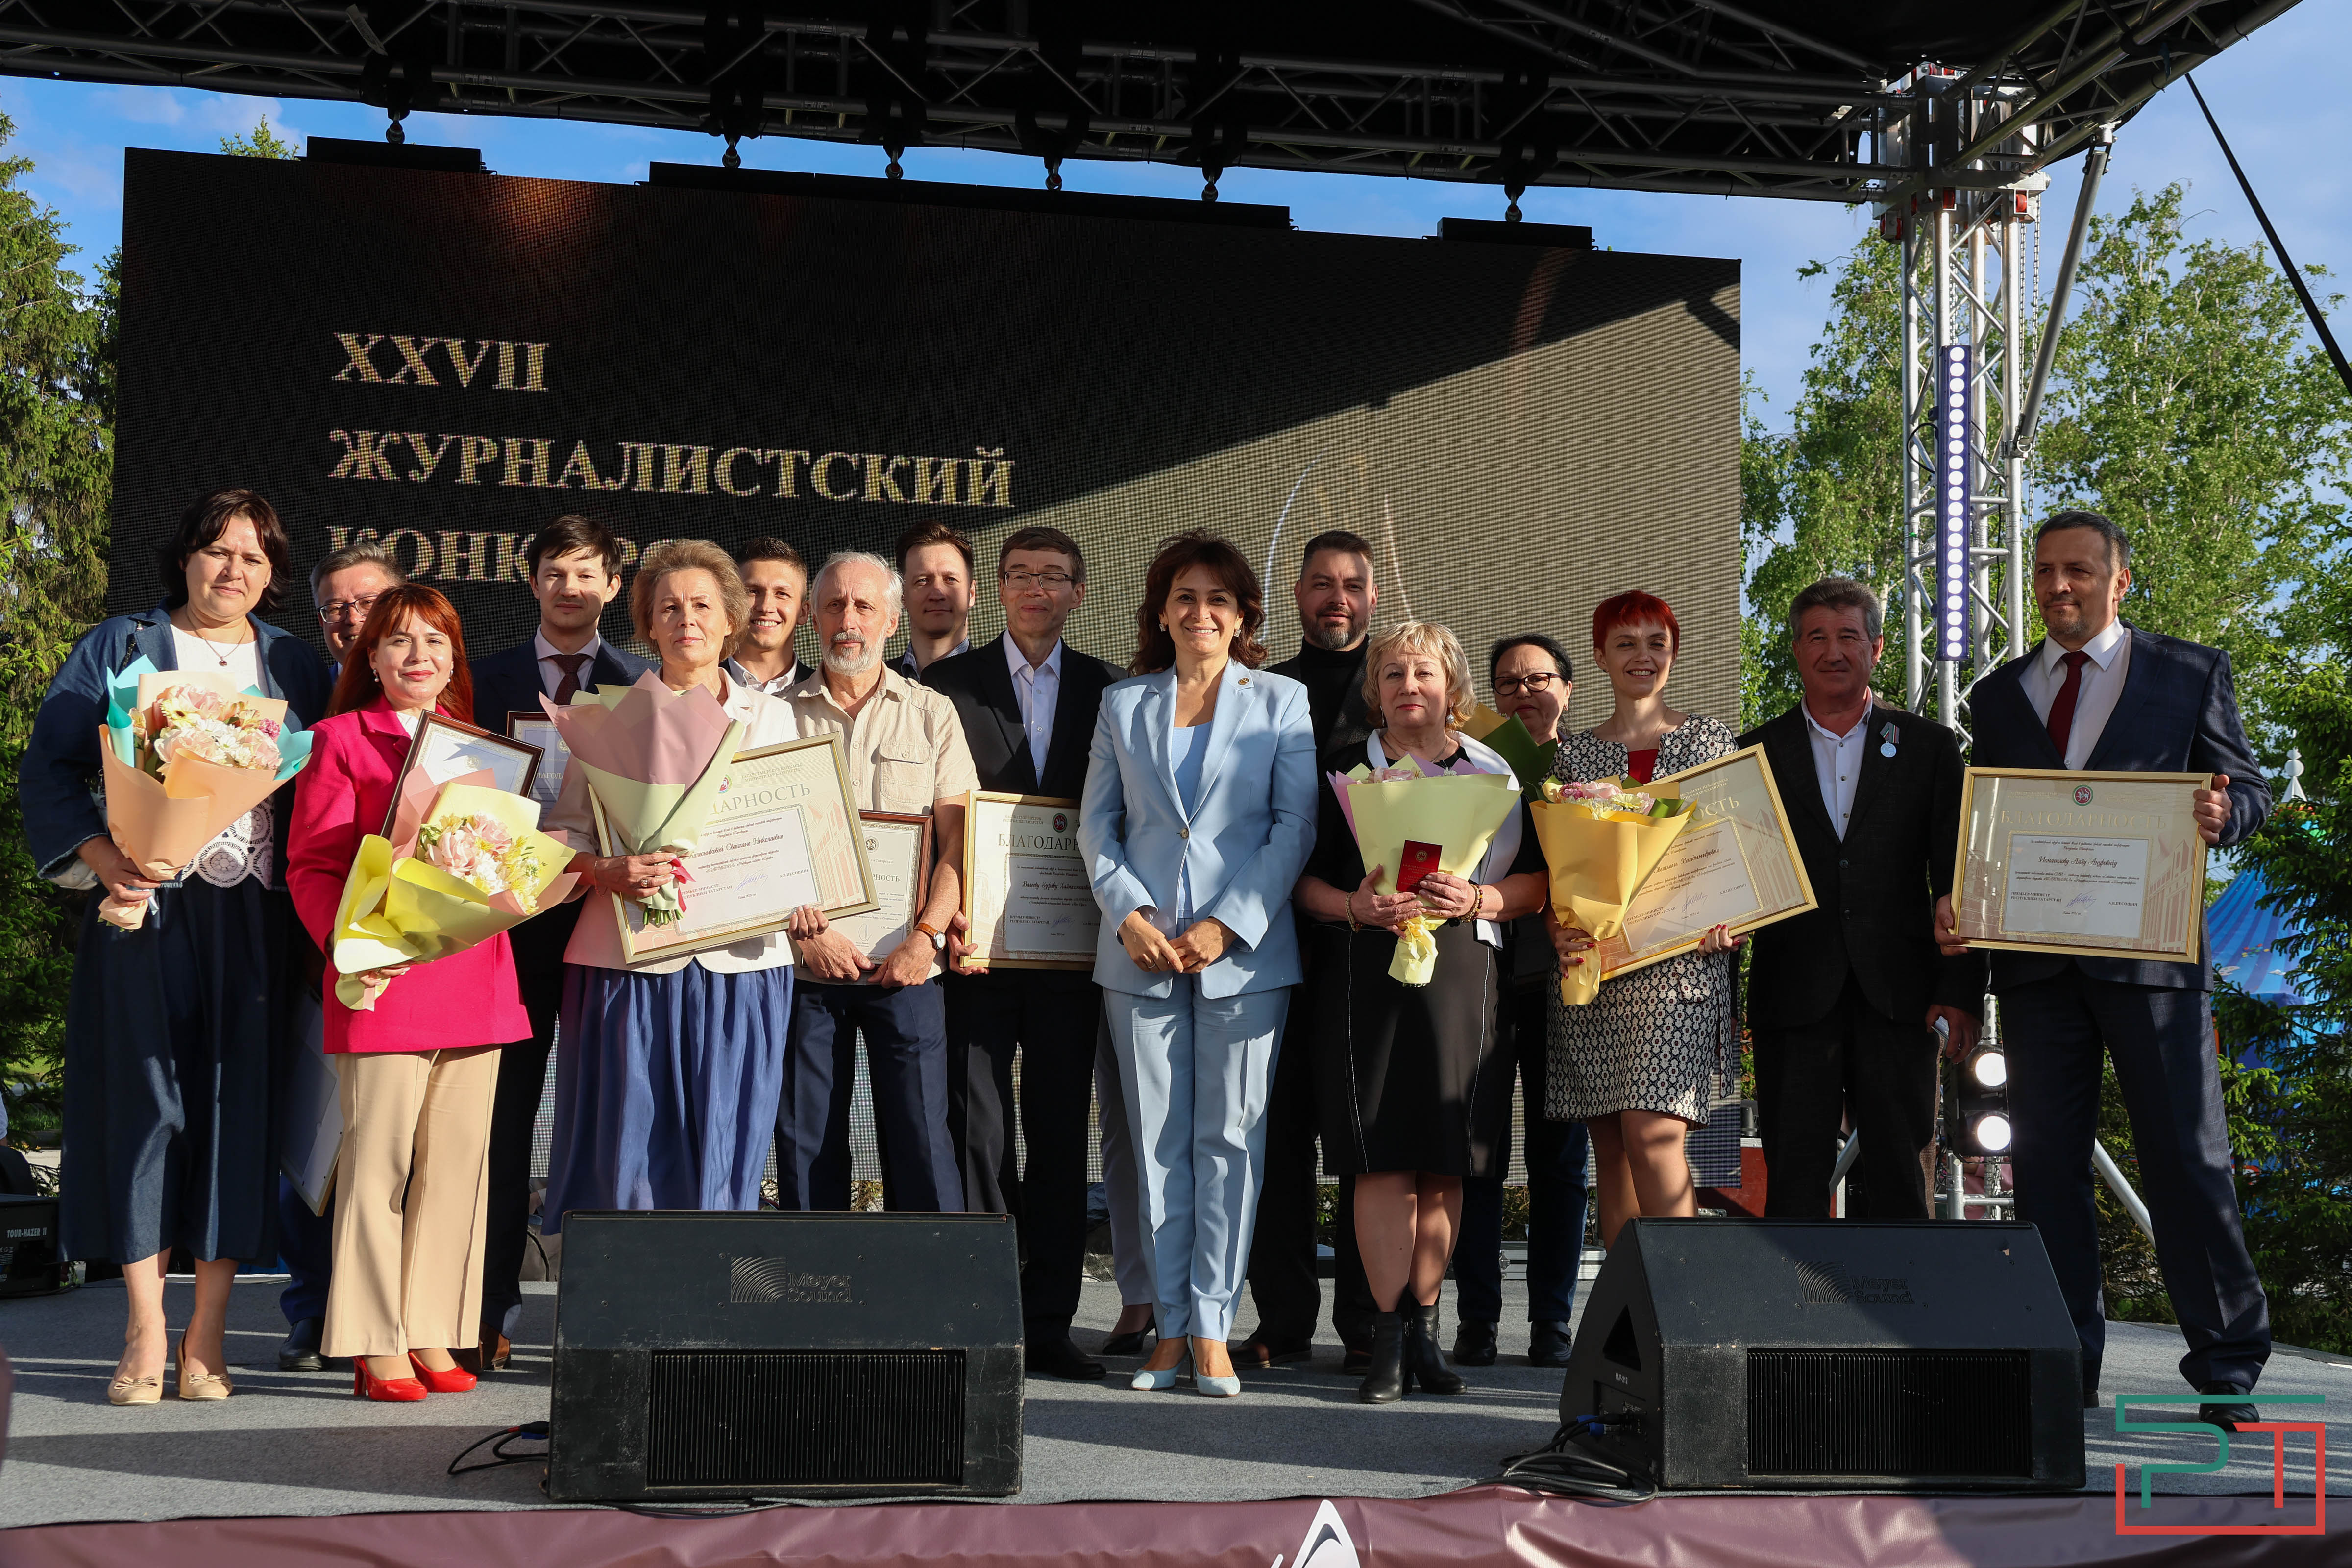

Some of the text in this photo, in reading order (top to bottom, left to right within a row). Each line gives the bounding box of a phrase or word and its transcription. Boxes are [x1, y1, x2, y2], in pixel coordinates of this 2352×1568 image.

[331, 332, 550, 392] XXVII
[327, 429, 1016, 508] ЖУРНАЛИСТСКИЙ
[710, 783, 810, 815] ДАРНОСТЬ
[2001, 810, 2166, 829] БЛАГОДАРНОСТЬ
[999, 834, 1080, 851] БЛАГОДАРН
[681, 884, 719, 895] РЕМЬЕР-МИНИСТР
[708, 885, 733, 895] ТАТАРСТАН
[1626, 906, 1664, 921] ПРЕМЬЕР-МИНИСТР
[1627, 915, 1653, 926] РЕСПУБЛИКИ
[1653, 906, 1676, 918] ТАТАРСТАН
[788, 1272, 852, 1290] Meyer
[1851, 1276, 1908, 1291] Meyer
[788, 1288, 853, 1303] Sound
[1853, 1290, 1915, 1304] Sound
